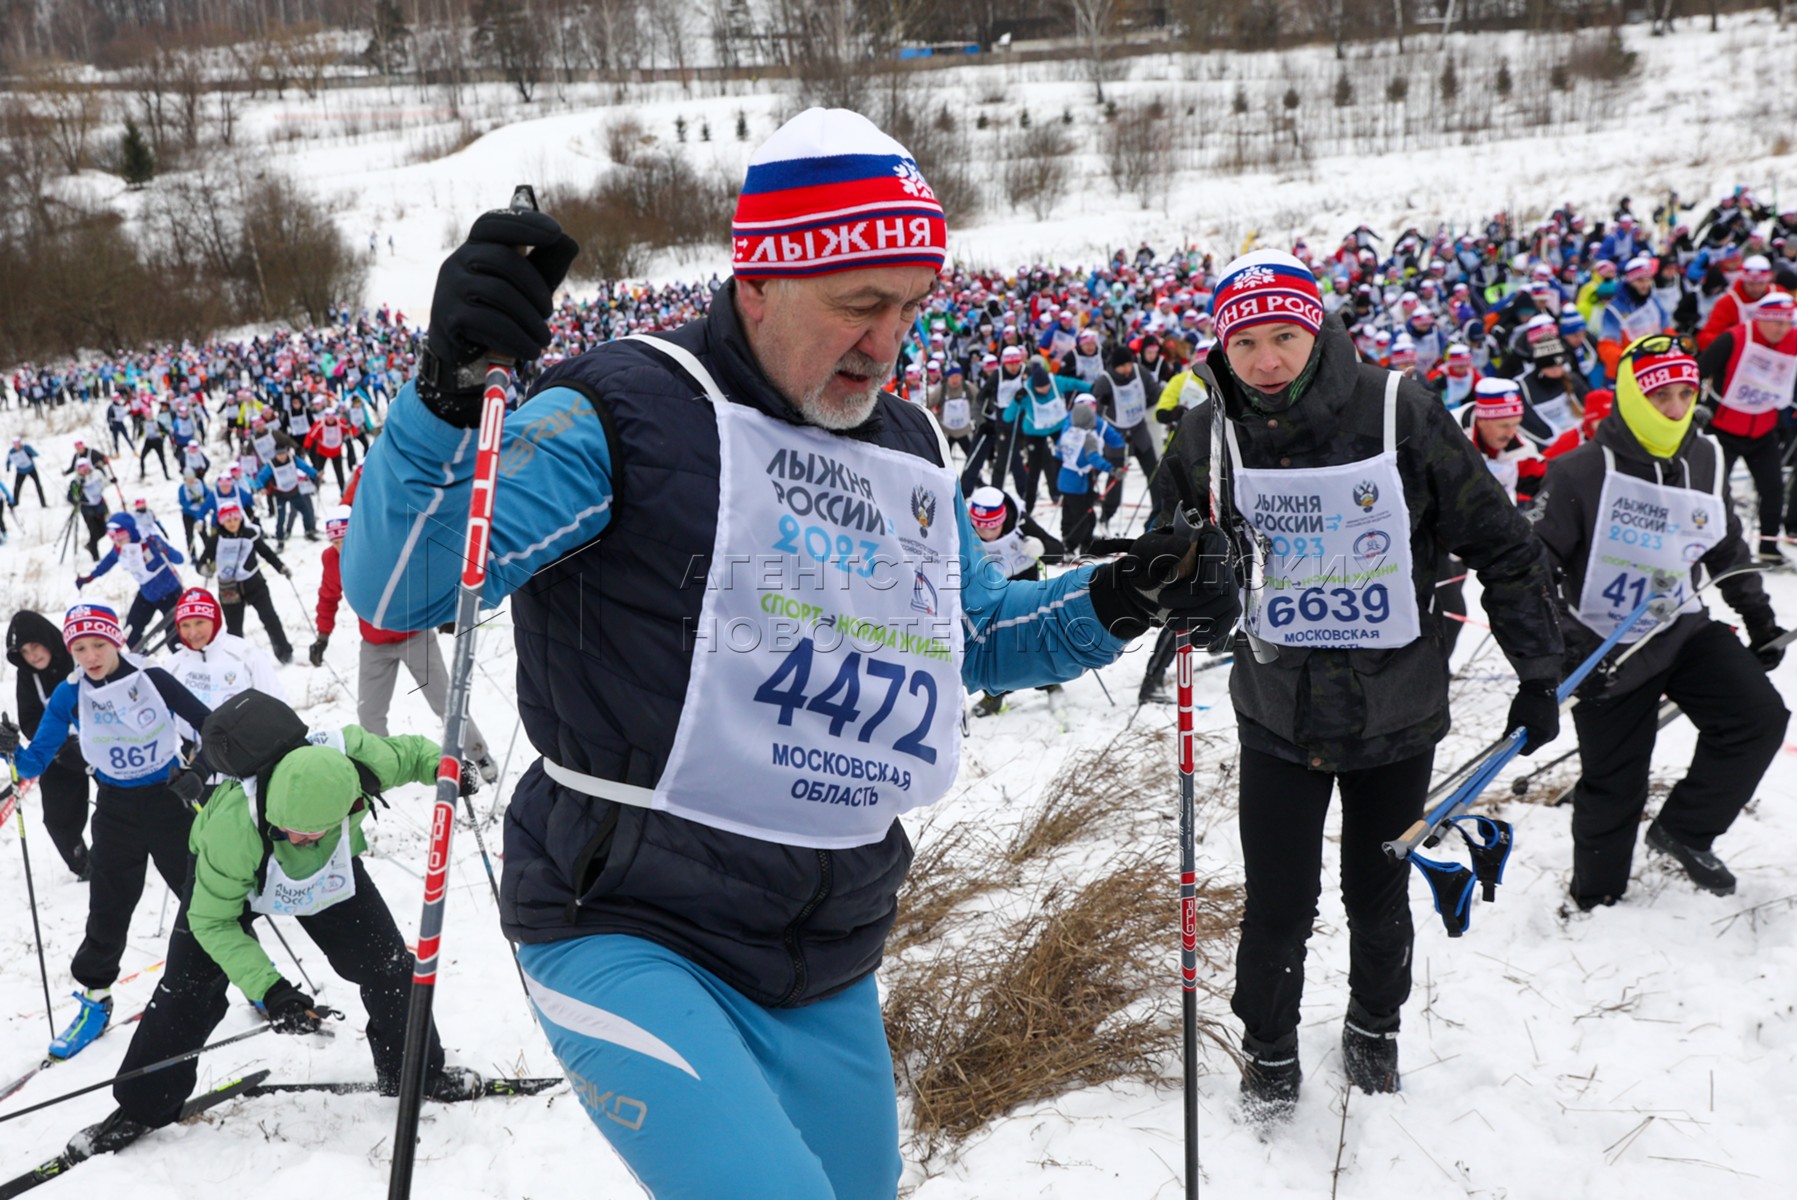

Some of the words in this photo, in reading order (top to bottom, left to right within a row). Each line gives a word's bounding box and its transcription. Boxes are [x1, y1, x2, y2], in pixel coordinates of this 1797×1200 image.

[749, 217, 931, 262] ЛЫЖНЯ
[766, 448, 876, 504] ЛЫЖНЯ
[771, 478, 886, 536] РОССИИ
[1254, 494, 1322, 513] ЛЫЖНЯ
[1611, 510, 1667, 533] РОССИИ
[1612, 497, 1669, 519] ЛЫЖНЯ
[1255, 512, 1324, 533] РОССИИ
[1608, 525, 1663, 551] 2023
[772, 514, 880, 578] 2023
[1270, 536, 1325, 558] 023
[1267, 583, 1390, 628] 6639
[1602, 572, 1684, 611] 411
[760, 593, 823, 627] СПОРТ
[836, 613, 896, 649] НОРМА
[1284, 629, 1380, 643] МОСКОВСКАЯ
[753, 637, 938, 766] 4472
[109, 739, 159, 769] 867
[772, 742, 912, 791] МОСКОВСКАЯ
[791, 778, 879, 807] ОБЛАСТЬ
[429, 806, 448, 869] POLO
[1186, 899, 1195, 933] POLO
